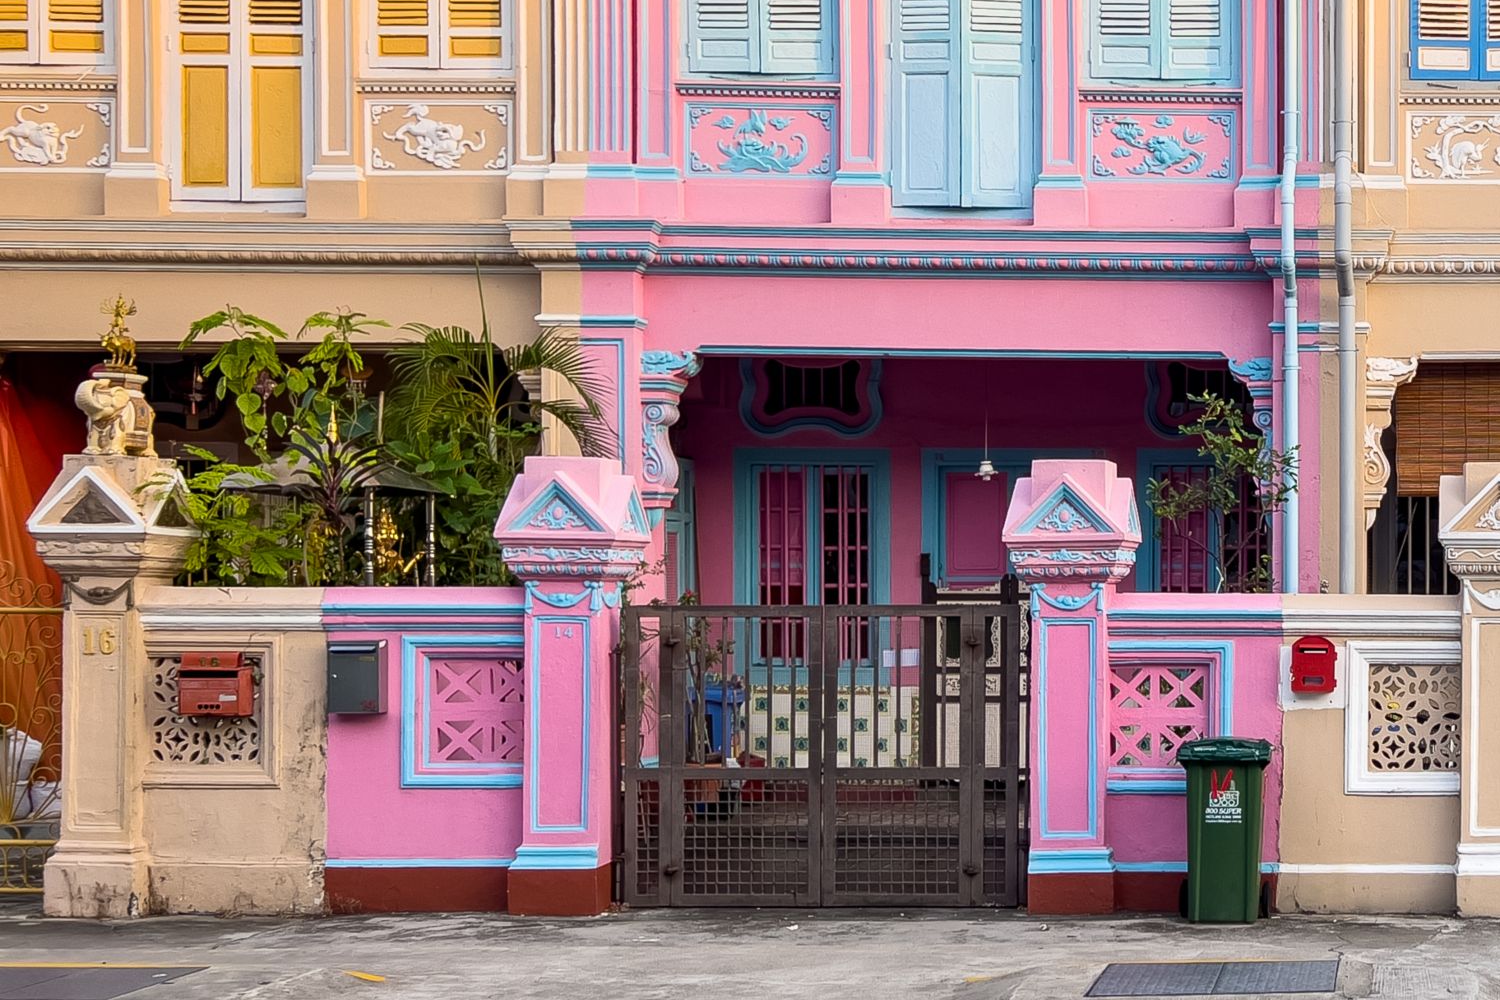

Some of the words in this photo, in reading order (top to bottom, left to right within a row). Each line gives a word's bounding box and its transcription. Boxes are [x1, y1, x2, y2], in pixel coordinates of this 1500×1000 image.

[555, 626, 573, 639] 14
[83, 626, 116, 655] 16
[1219, 807, 1242, 815] SUPER
